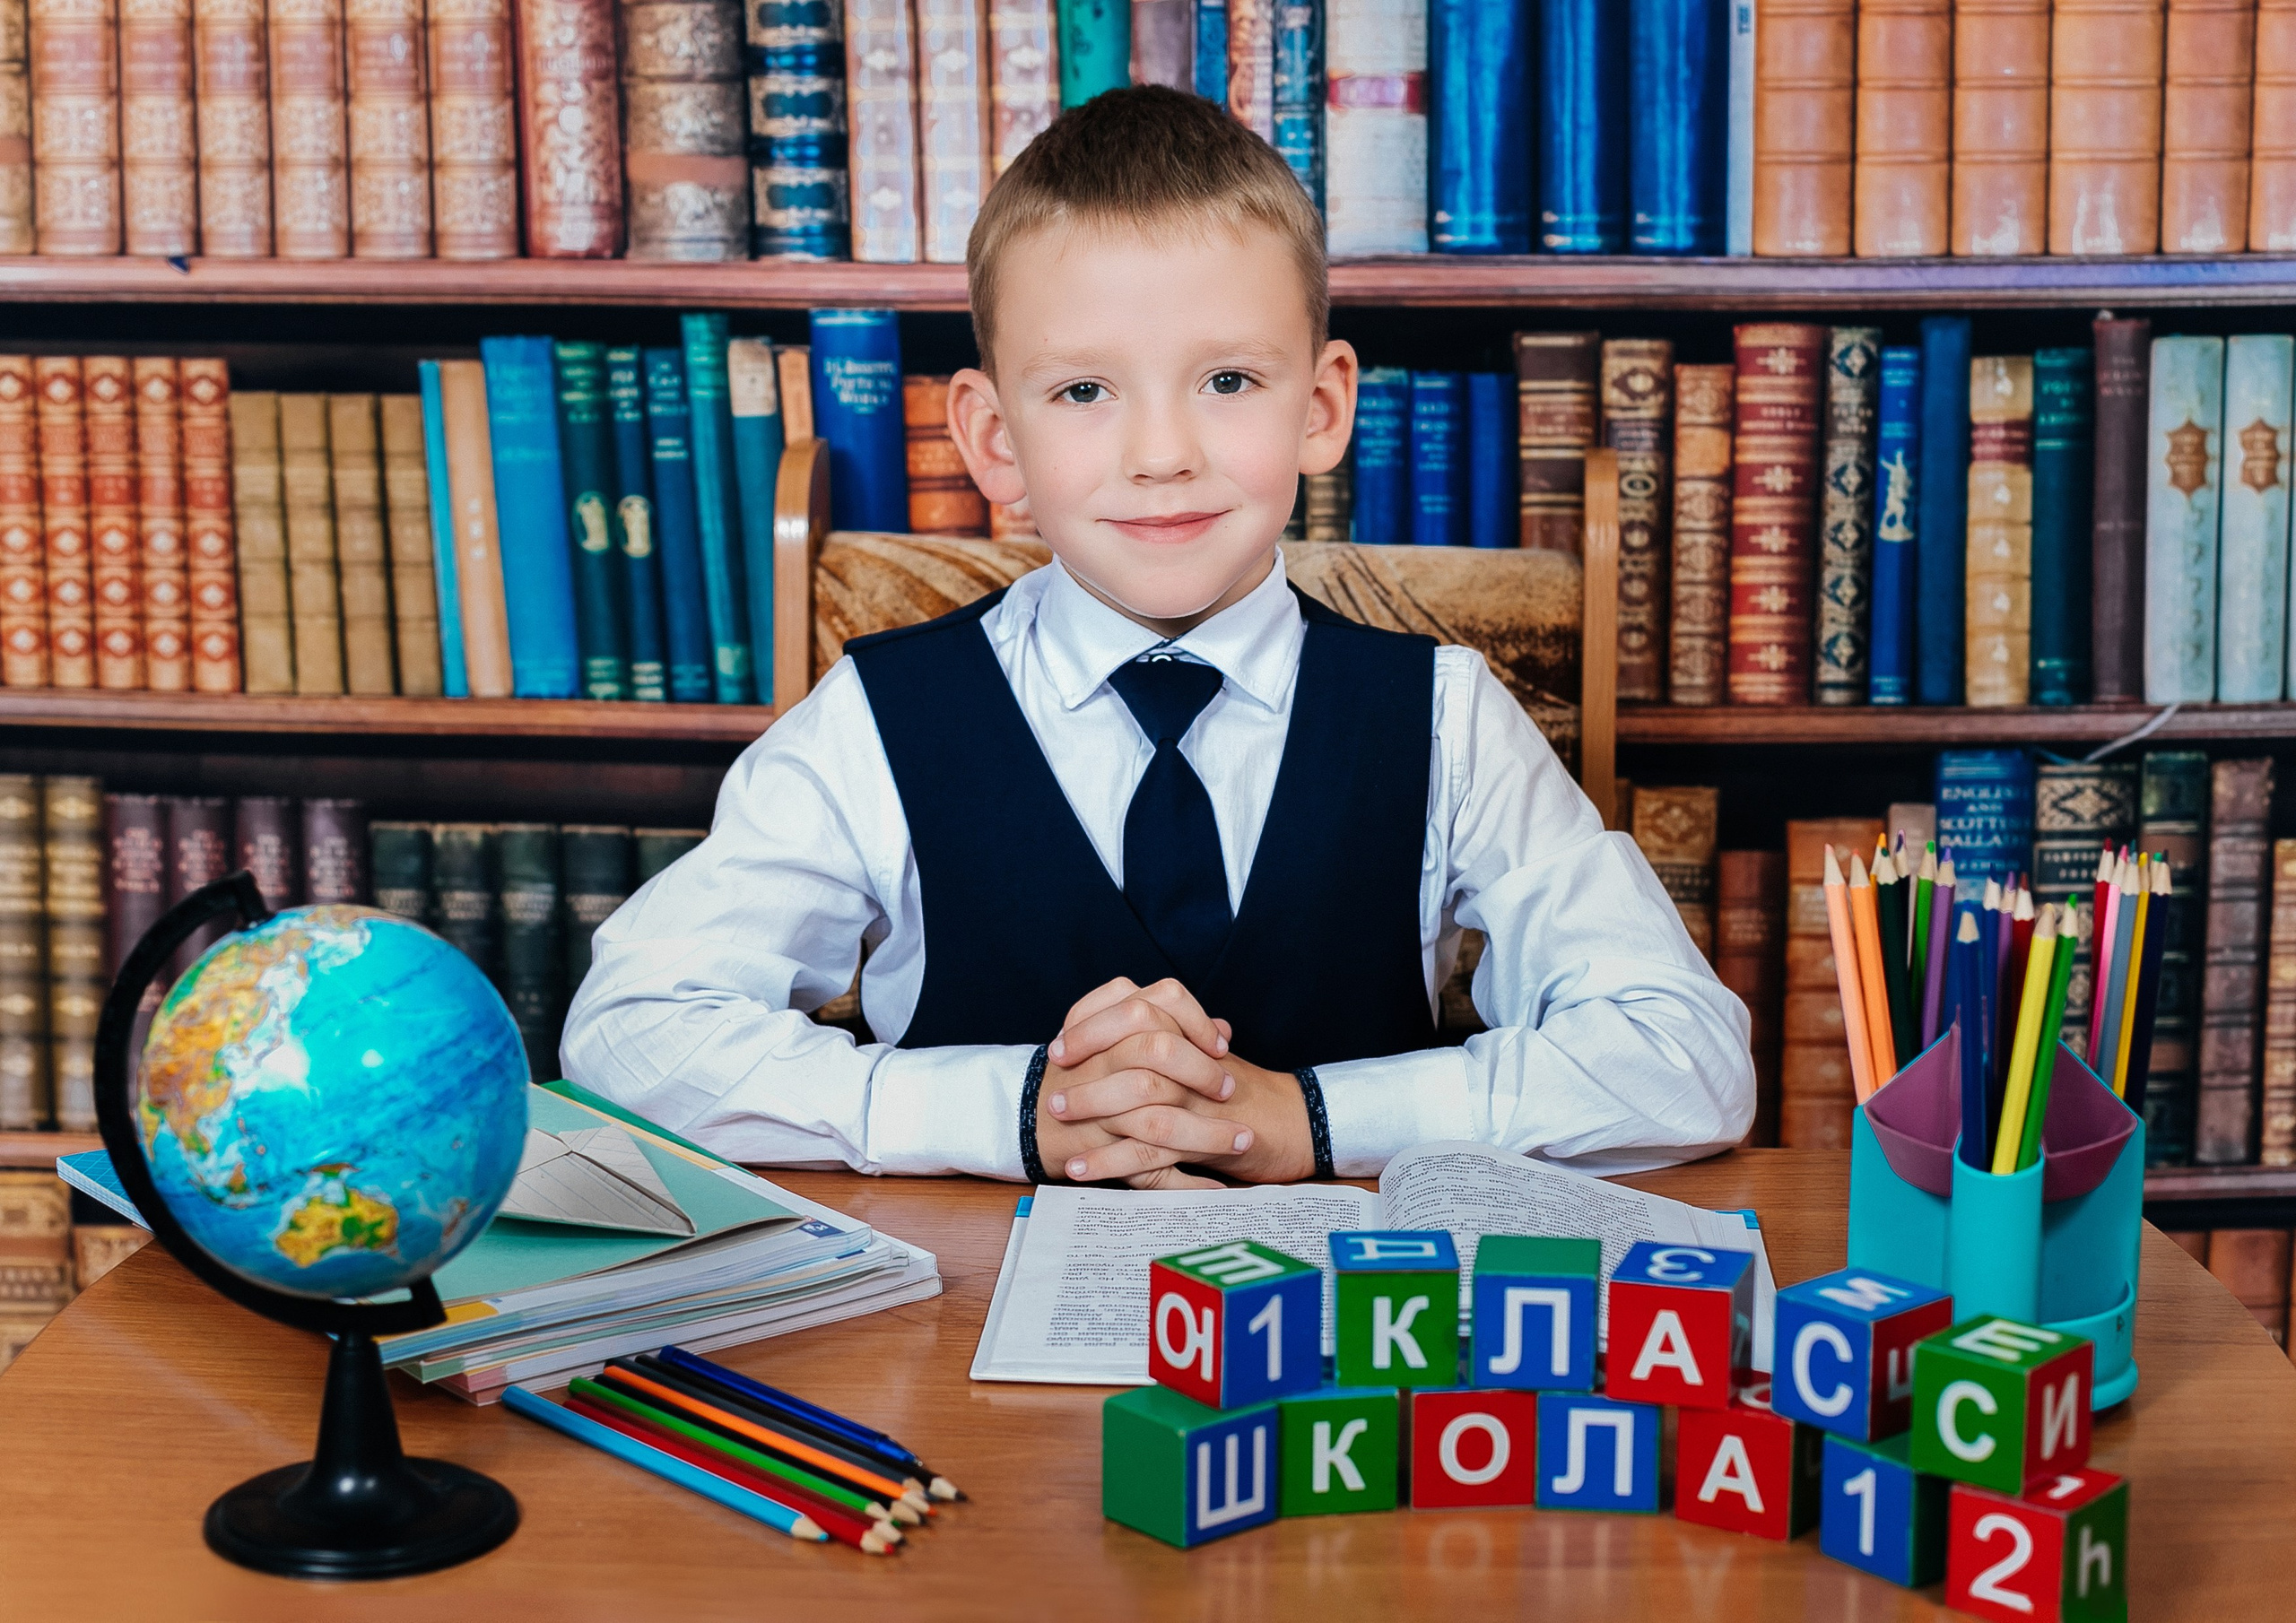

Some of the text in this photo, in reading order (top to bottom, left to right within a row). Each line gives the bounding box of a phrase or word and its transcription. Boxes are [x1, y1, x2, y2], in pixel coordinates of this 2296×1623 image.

[1938, 817, 2029, 830] SCOTTI
[1942, 786, 2029, 801] ENGLIS
[1939, 833, 2029, 847] BALLA
[1155, 1291, 1214, 1383] Ю
[1248, 1294, 1283, 1382] 1
[1371, 1296, 1430, 1369] К
[1488, 1287, 1570, 1376] Л
[1630, 1309, 1703, 1386] А
[1792, 1320, 1853, 1418] С
[1311, 1419, 1368, 1494] К
[1439, 1412, 1512, 1486] О
[1552, 1408, 1636, 1497] Л
[1936, 1379, 1998, 1462] С
[2040, 1372, 2080, 1461] И
[1196, 1425, 1266, 1531] Ш
[1697, 1434, 1765, 1514] А
[1842, 1467, 1878, 1557] 1
[1968, 1512, 2035, 1613] 2
